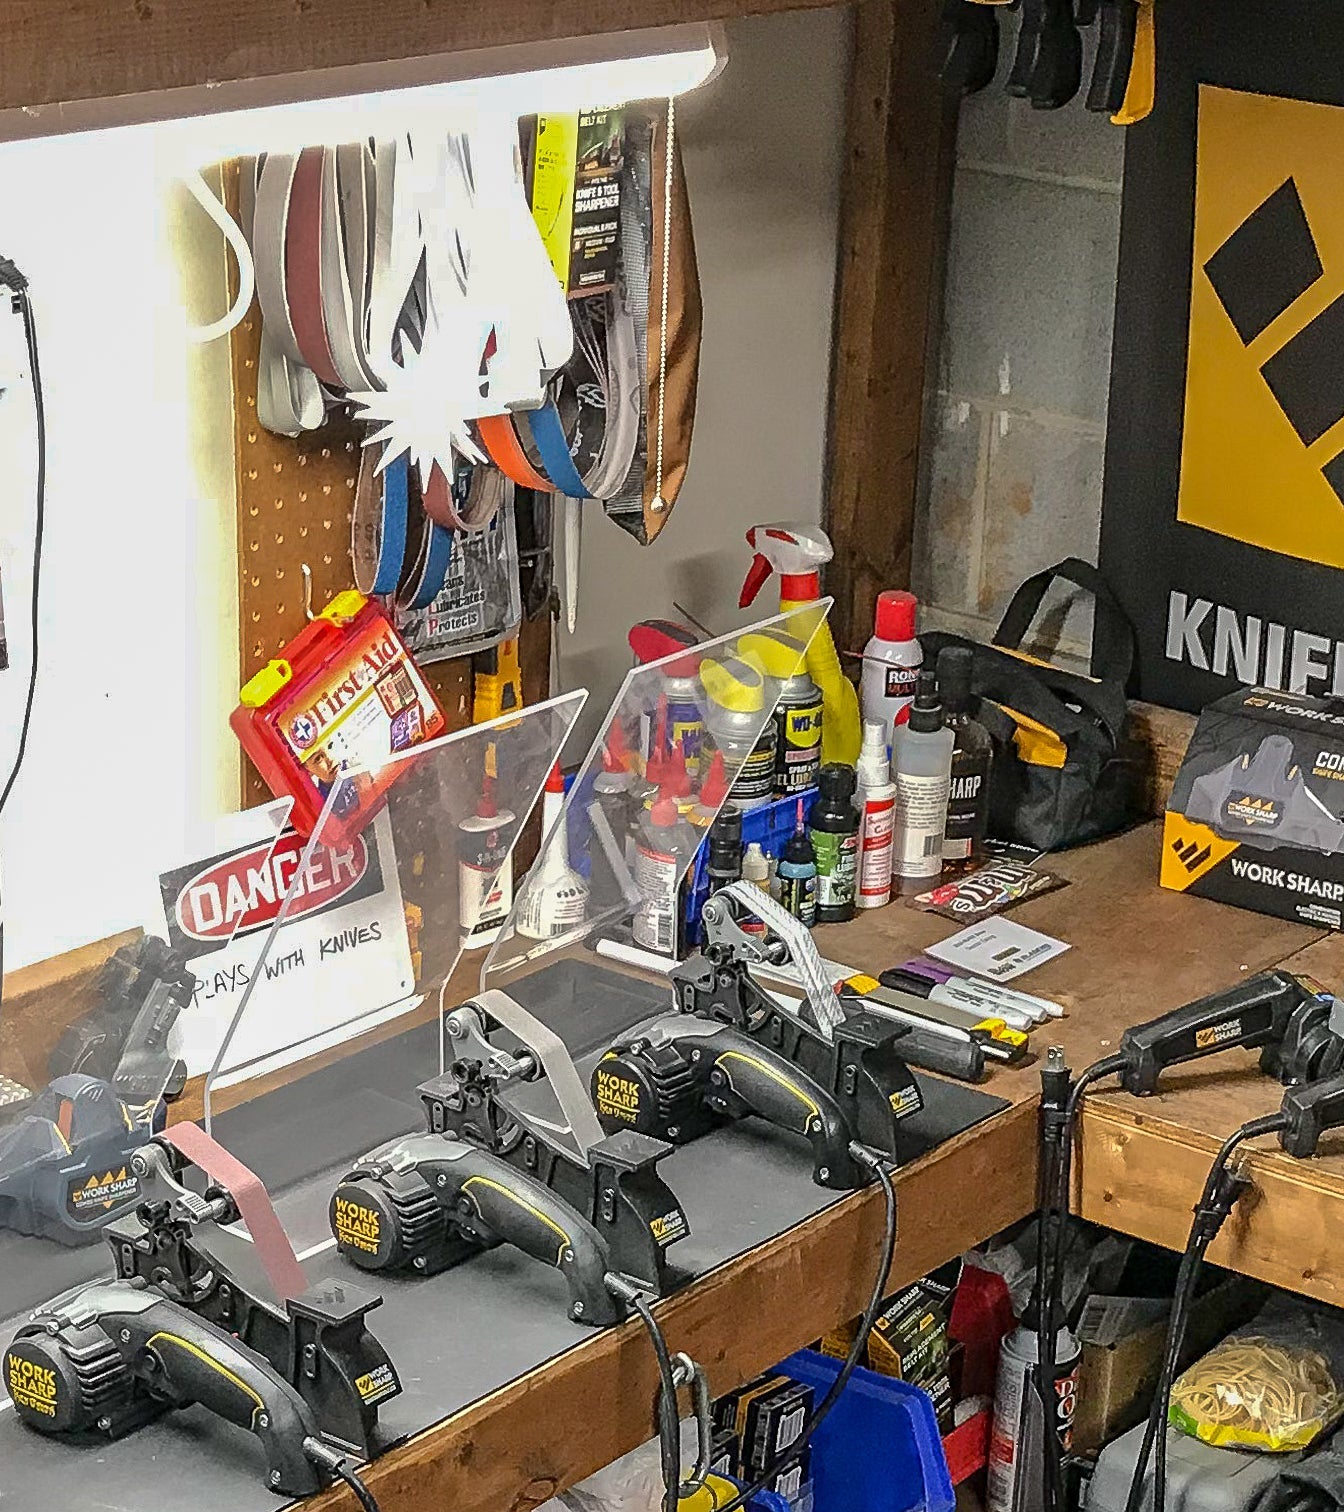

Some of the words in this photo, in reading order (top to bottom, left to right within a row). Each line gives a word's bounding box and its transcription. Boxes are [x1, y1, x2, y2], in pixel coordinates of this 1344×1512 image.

[427, 611, 479, 637] Protects
[361, 631, 399, 673] Aid
[1267, 701, 1331, 722] WORK
[188, 846, 358, 933] DANGER
[1231, 859, 1287, 888] WORK
[1287, 869, 1344, 902] SHARP
[263, 949, 305, 980] WITH
[319, 922, 382, 961] KNIVES
[1213, 1018, 1241, 1034] WORK
[1214, 1026, 1242, 1042] SHARP
[597, 1084, 640, 1108] SHARP
[598, 1069, 640, 1097] WORK
[82, 1185, 110, 1199] WORK
[110, 1177, 138, 1193] SHARP
[336, 1196, 380, 1226] WORK
[336, 1211, 380, 1238] SHARP
[9, 1353, 56, 1387] WORK
[9, 1369, 57, 1399] SHARP
